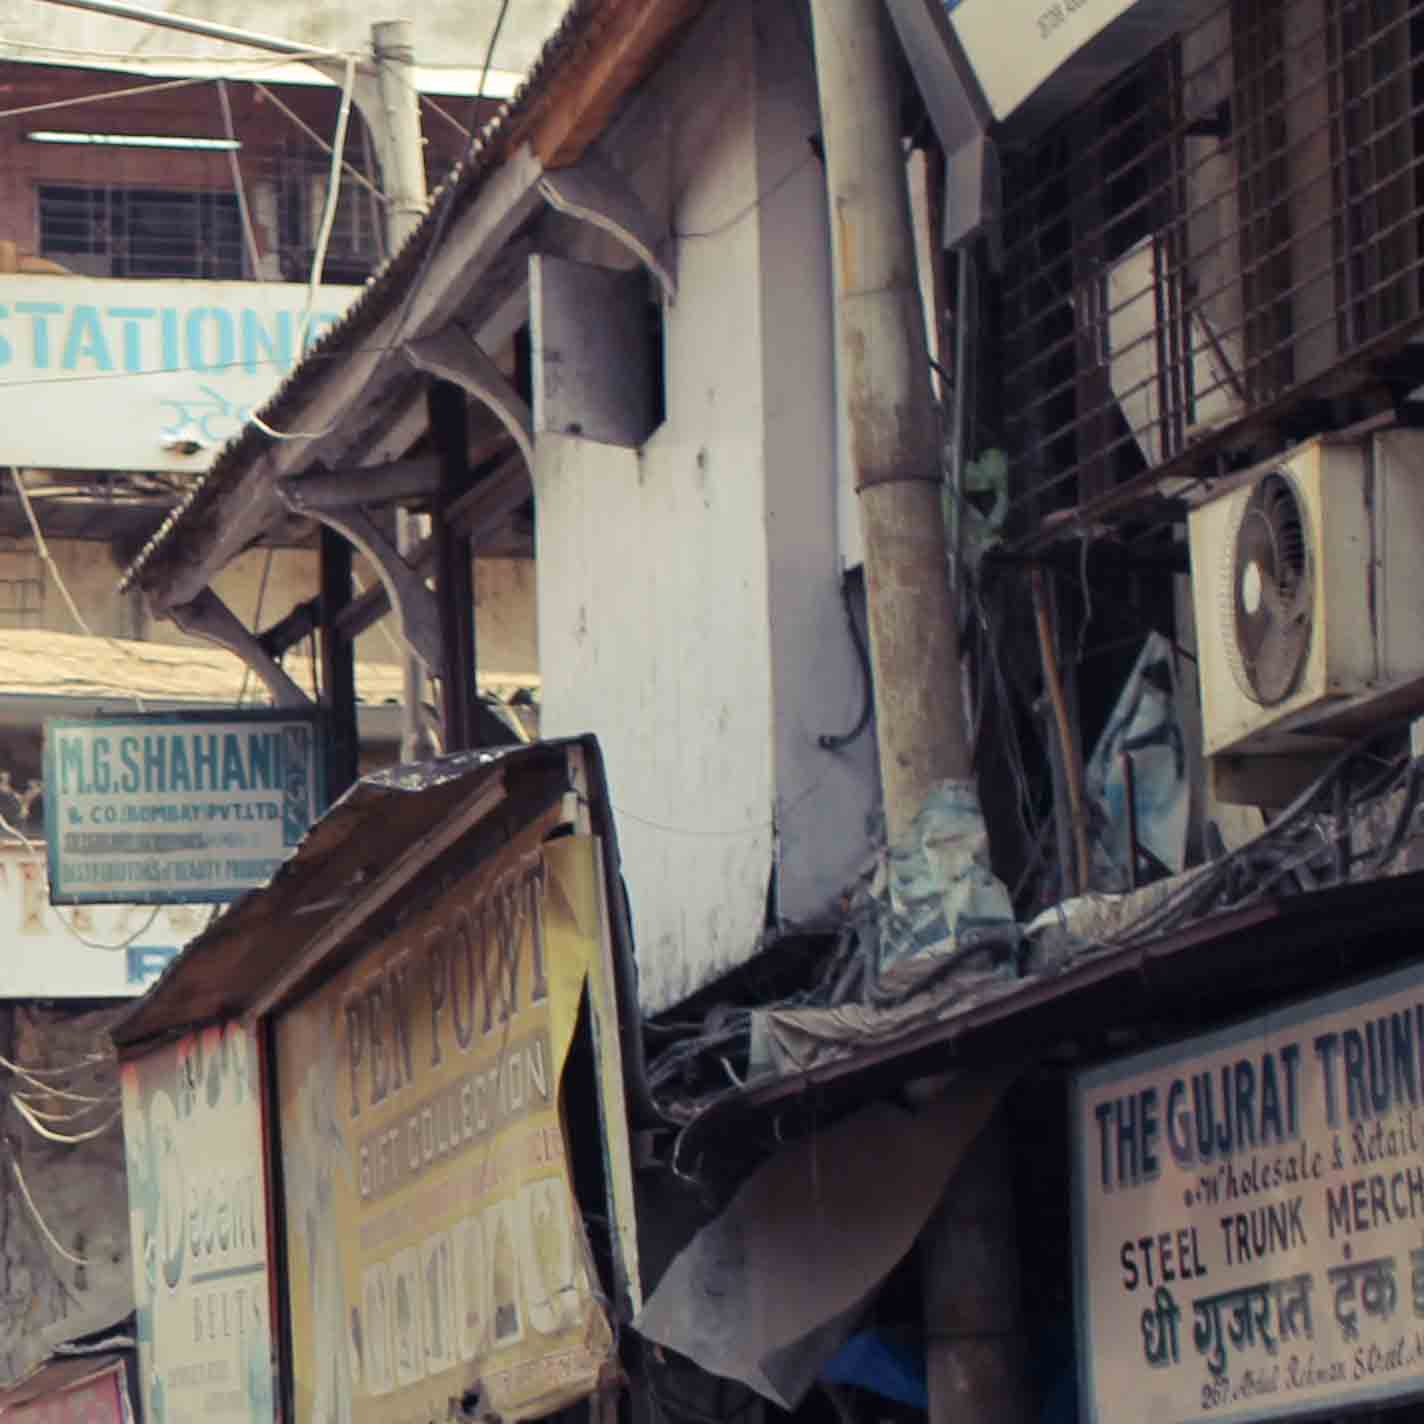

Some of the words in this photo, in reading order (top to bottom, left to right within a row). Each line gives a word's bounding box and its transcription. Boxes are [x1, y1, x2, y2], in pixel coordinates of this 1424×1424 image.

[59, 733, 284, 796] M.G.SHAHANI
[68, 804, 83, 825] &
[342, 950, 414, 1122] PEN
[358, 1126, 402, 1203] GIFT
[407, 1036, 552, 1174] COLLECTION
[1095, 1086, 1159, 1190] THE
[1166, 1042, 1299, 1171] GUJRAT
[1119, 1224, 1207, 1292] STEEL
[1220, 1196, 1308, 1268] TRUNK
[1192, 1271, 1314, 1378] गुजरात
